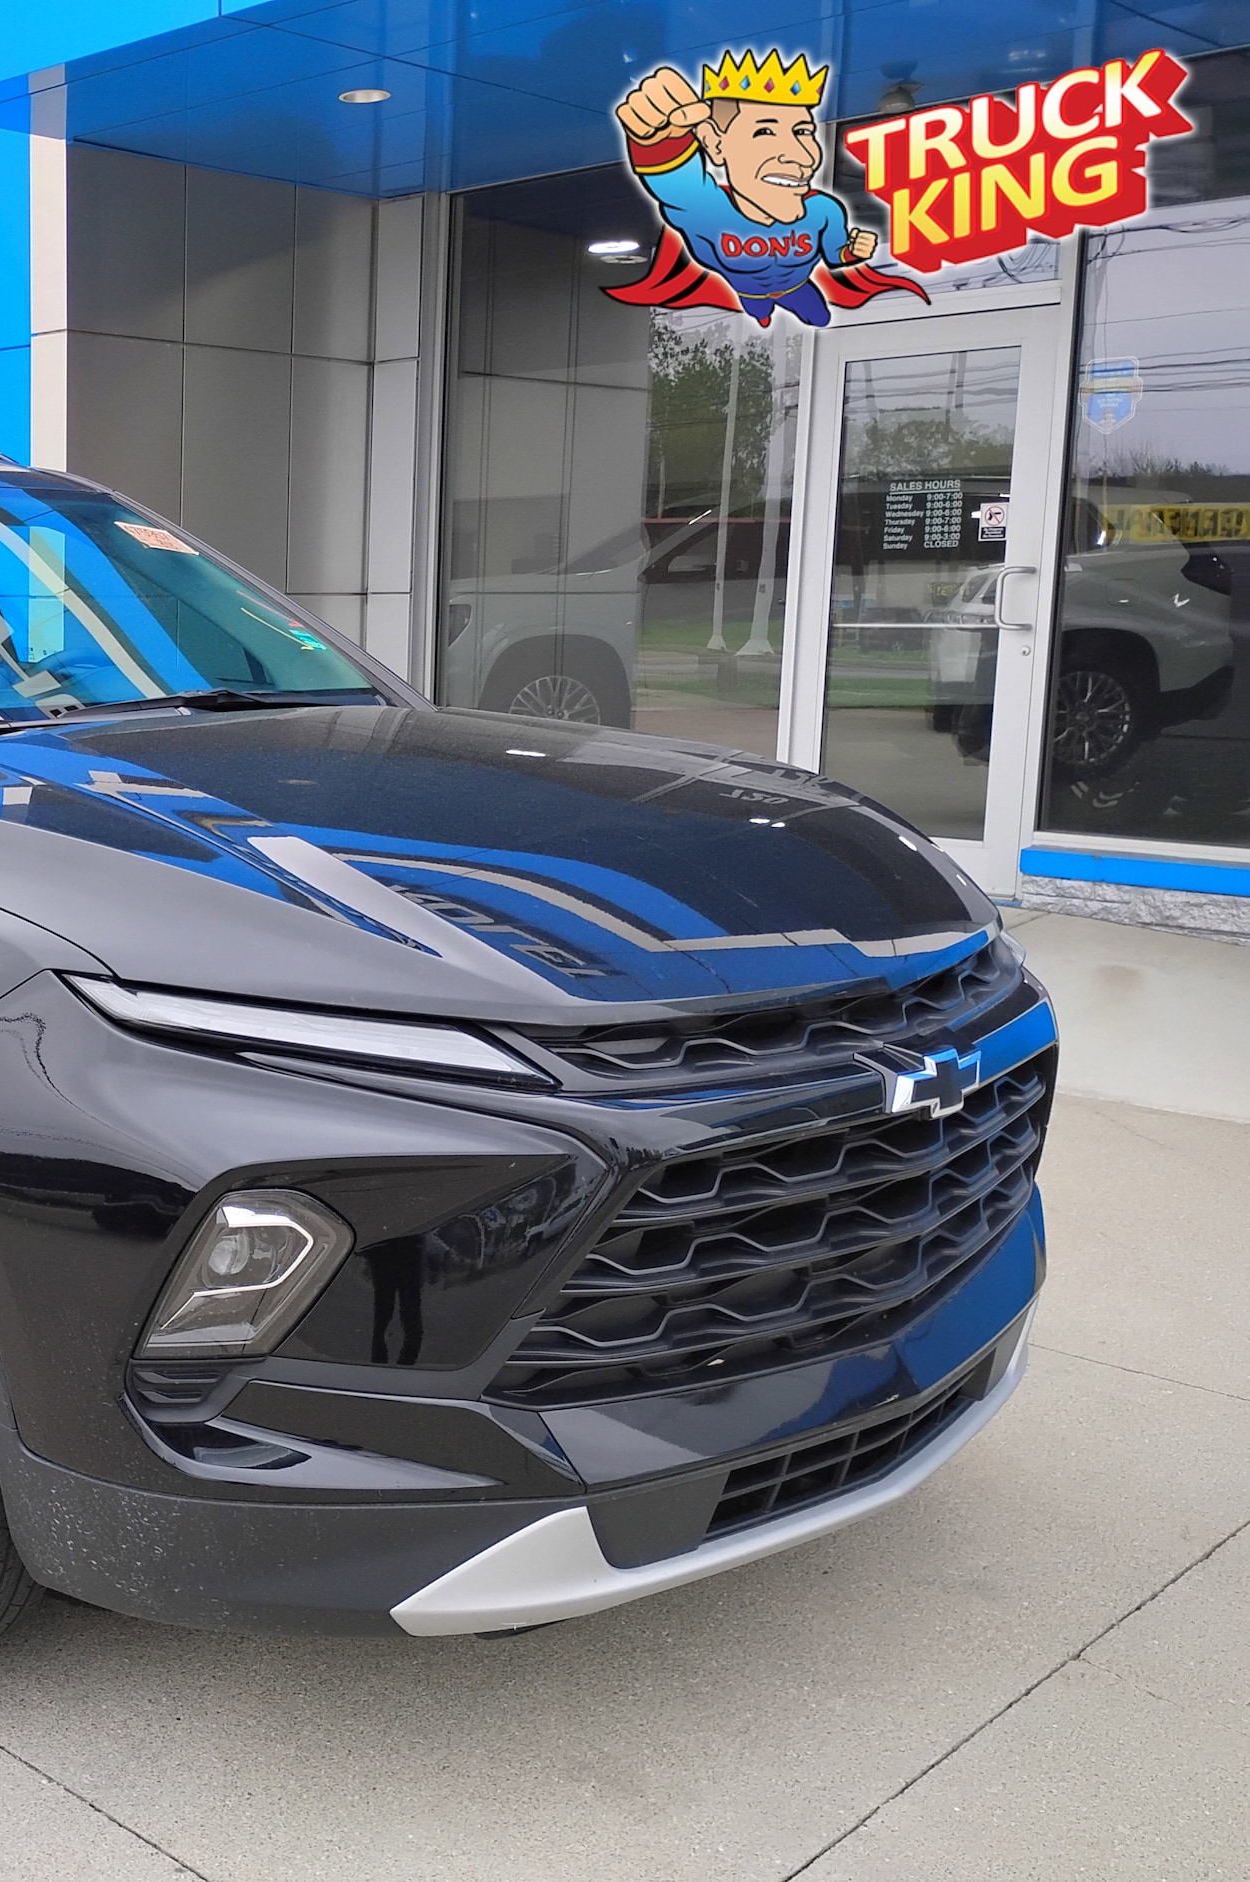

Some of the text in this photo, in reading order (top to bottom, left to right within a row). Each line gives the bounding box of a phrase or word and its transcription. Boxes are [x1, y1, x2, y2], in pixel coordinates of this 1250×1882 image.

[889, 479, 961, 492] SALES HOURS
[885, 494, 913, 502] Monday
[885, 510, 924, 518] Wednesday
[885, 518, 916, 526] Thursday
[884, 526, 905, 534] Friday
[883, 534, 913, 542] Saturday
[882, 540, 959, 550] Sunday CLOSED
